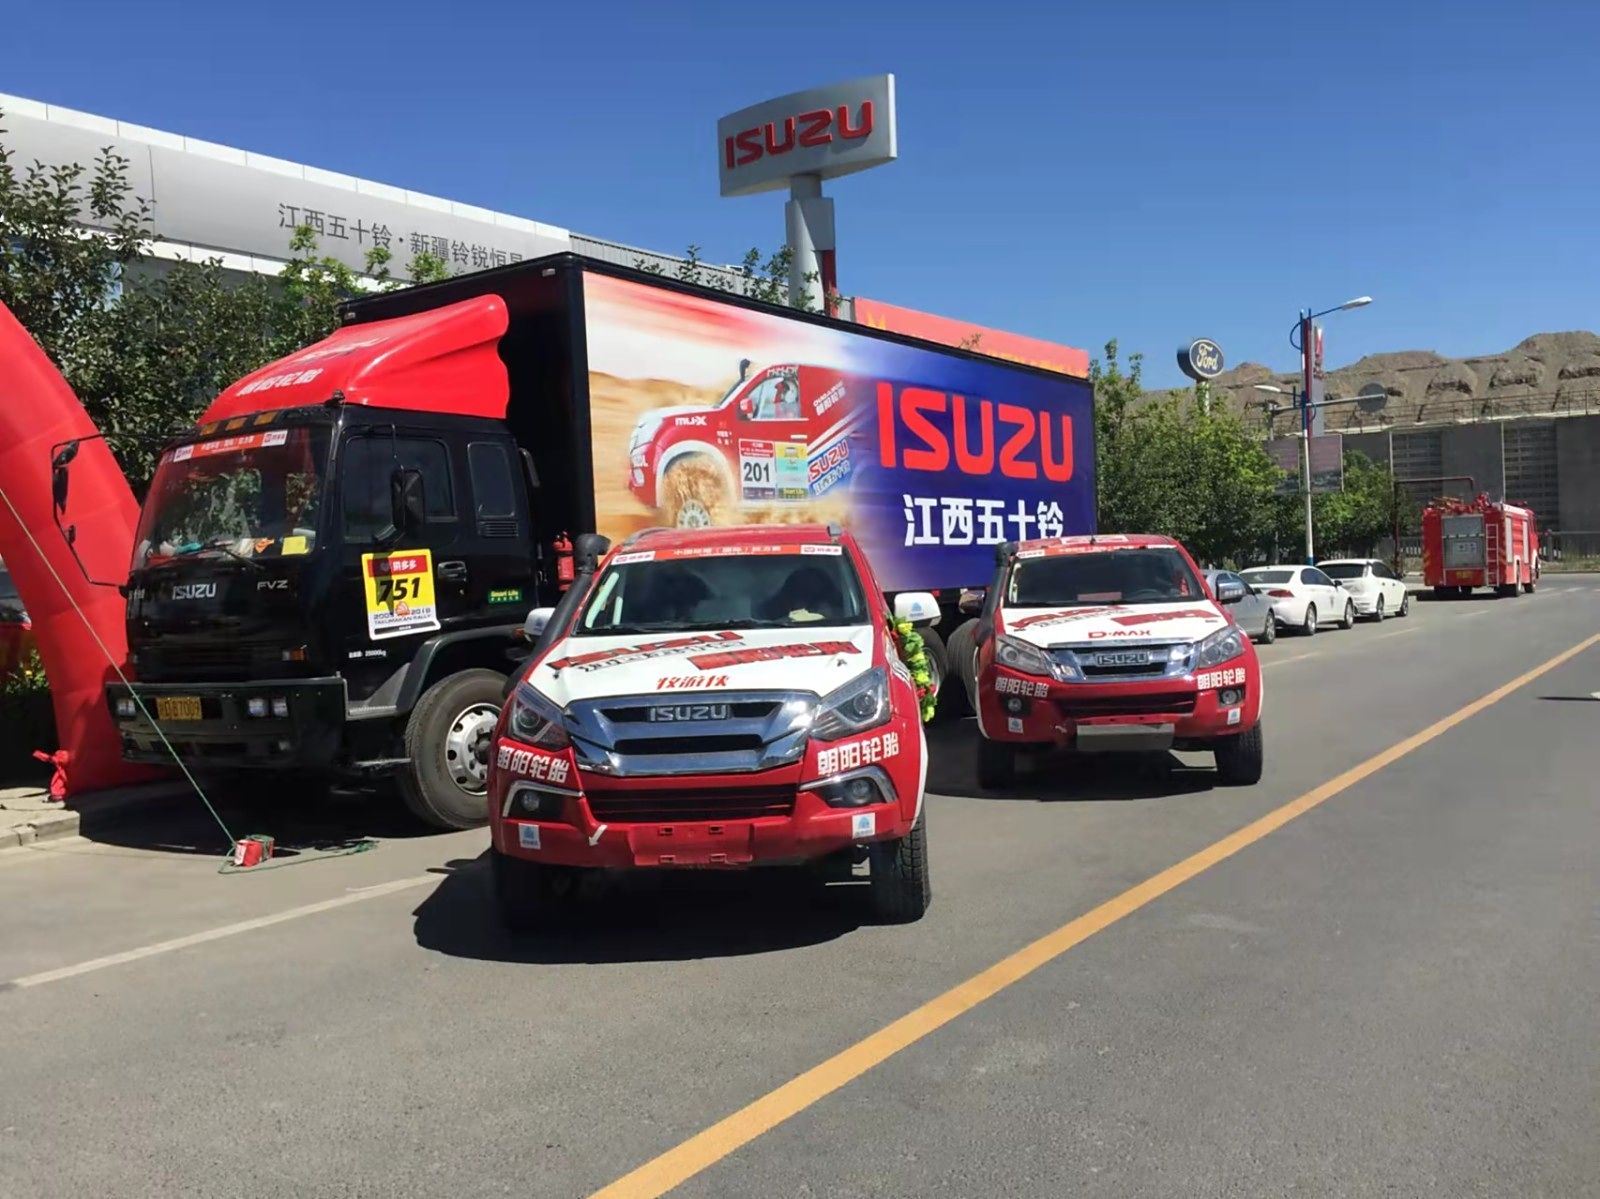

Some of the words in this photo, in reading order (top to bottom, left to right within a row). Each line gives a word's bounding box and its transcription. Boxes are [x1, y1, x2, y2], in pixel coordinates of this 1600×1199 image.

[725, 100, 875, 169] ISUZU
[1196, 343, 1219, 370] Ford
[876, 382, 1074, 482] ISUZU
[743, 462, 770, 482] 201
[903, 494, 1064, 547] 江西五十铃
[172, 583, 217, 600] ISUZU
[257, 580, 289, 591] FVZ
[377, 577, 421, 602] 751
[1098, 652, 1148, 665] ISUZU
[650, 704, 728, 722] ISUZU
[497, 745, 570, 784] 朝阳轮胎
[817, 731, 900, 778] 朝阳轮胎
